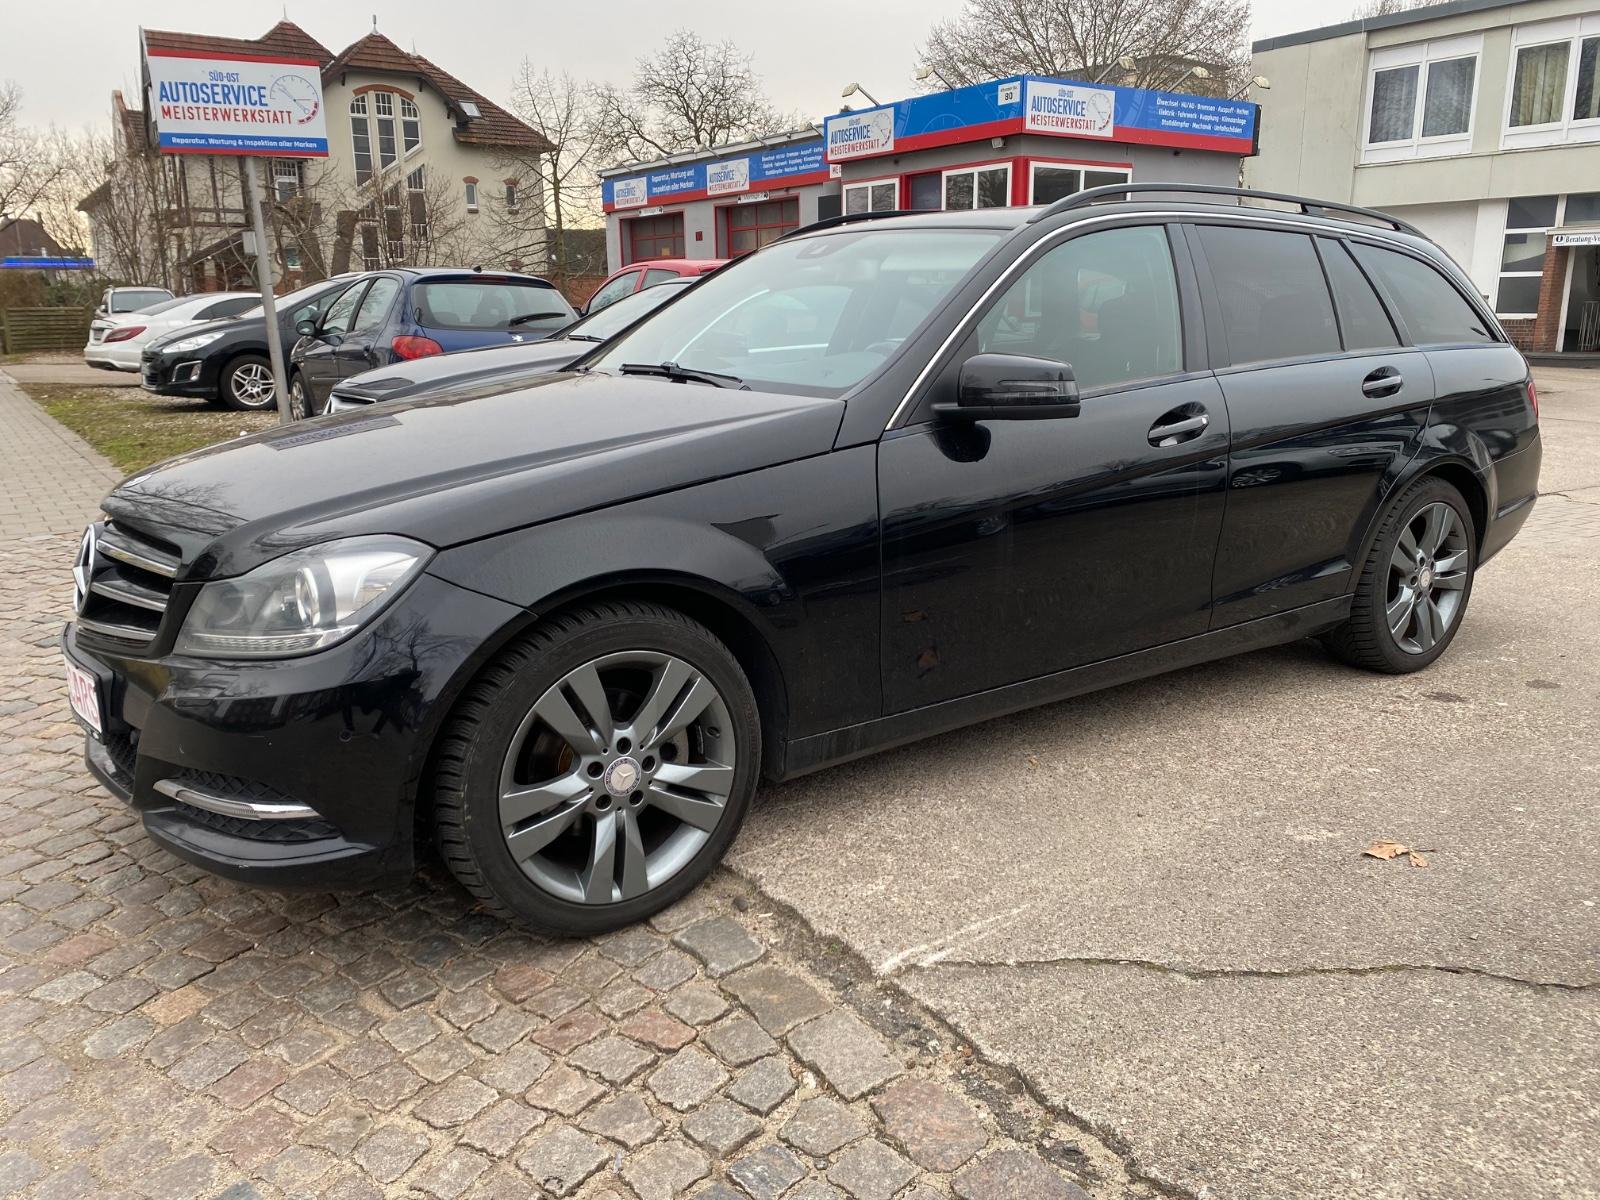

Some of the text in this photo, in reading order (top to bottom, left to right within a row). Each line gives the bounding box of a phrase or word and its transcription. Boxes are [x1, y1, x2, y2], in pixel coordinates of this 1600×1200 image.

[208, 70, 240, 82] SÜD-OST
[160, 81, 268, 106] AUTOSERVICE
[162, 106, 292, 124] MEISTERWERKSTATT
[1031, 96, 1086, 117] AUTOSERVICE
[1030, 114, 1096, 130] MEISTERWERKSTATT
[831, 124, 870, 144] AUTOSERVICE
[208, 138, 237, 146] Wartung
[244, 139, 278, 148] Inspektion
[830, 139, 880, 156] MEISTERWERKSTATT
